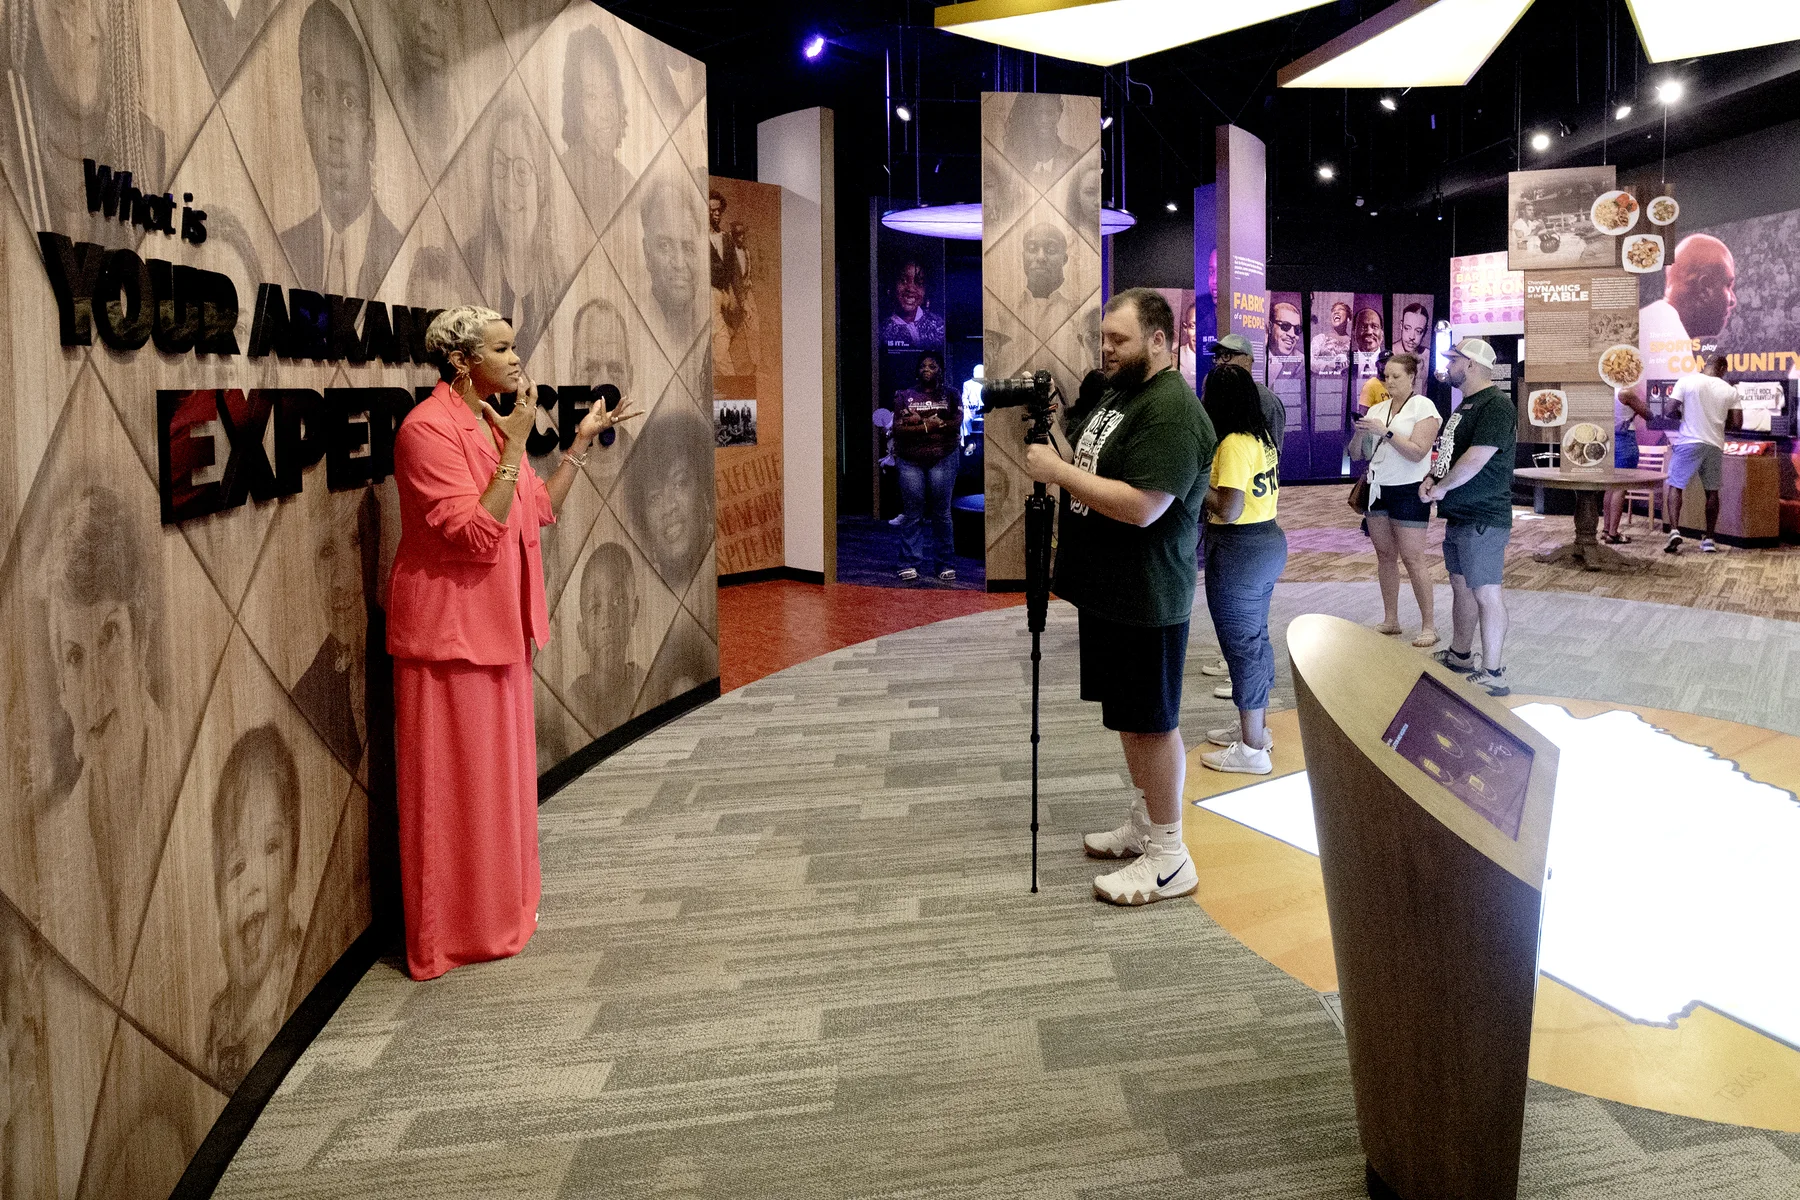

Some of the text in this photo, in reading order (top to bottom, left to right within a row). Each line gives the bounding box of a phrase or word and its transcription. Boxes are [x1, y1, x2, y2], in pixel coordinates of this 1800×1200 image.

[83, 158, 207, 243] What is
[37, 232, 512, 364] YOUR ARKAN
[1528, 284, 1581, 293] DYNAMICS
[1541, 291, 1589, 302] TABLE
[1233, 292, 1265, 313] FABRIC
[1234, 312, 1239, 320] of
[1242, 314, 1265, 330] PEOPLE
[1649, 339, 1718, 353] SPORTS play
[1712, 1065, 1767, 1103] TEXAS
